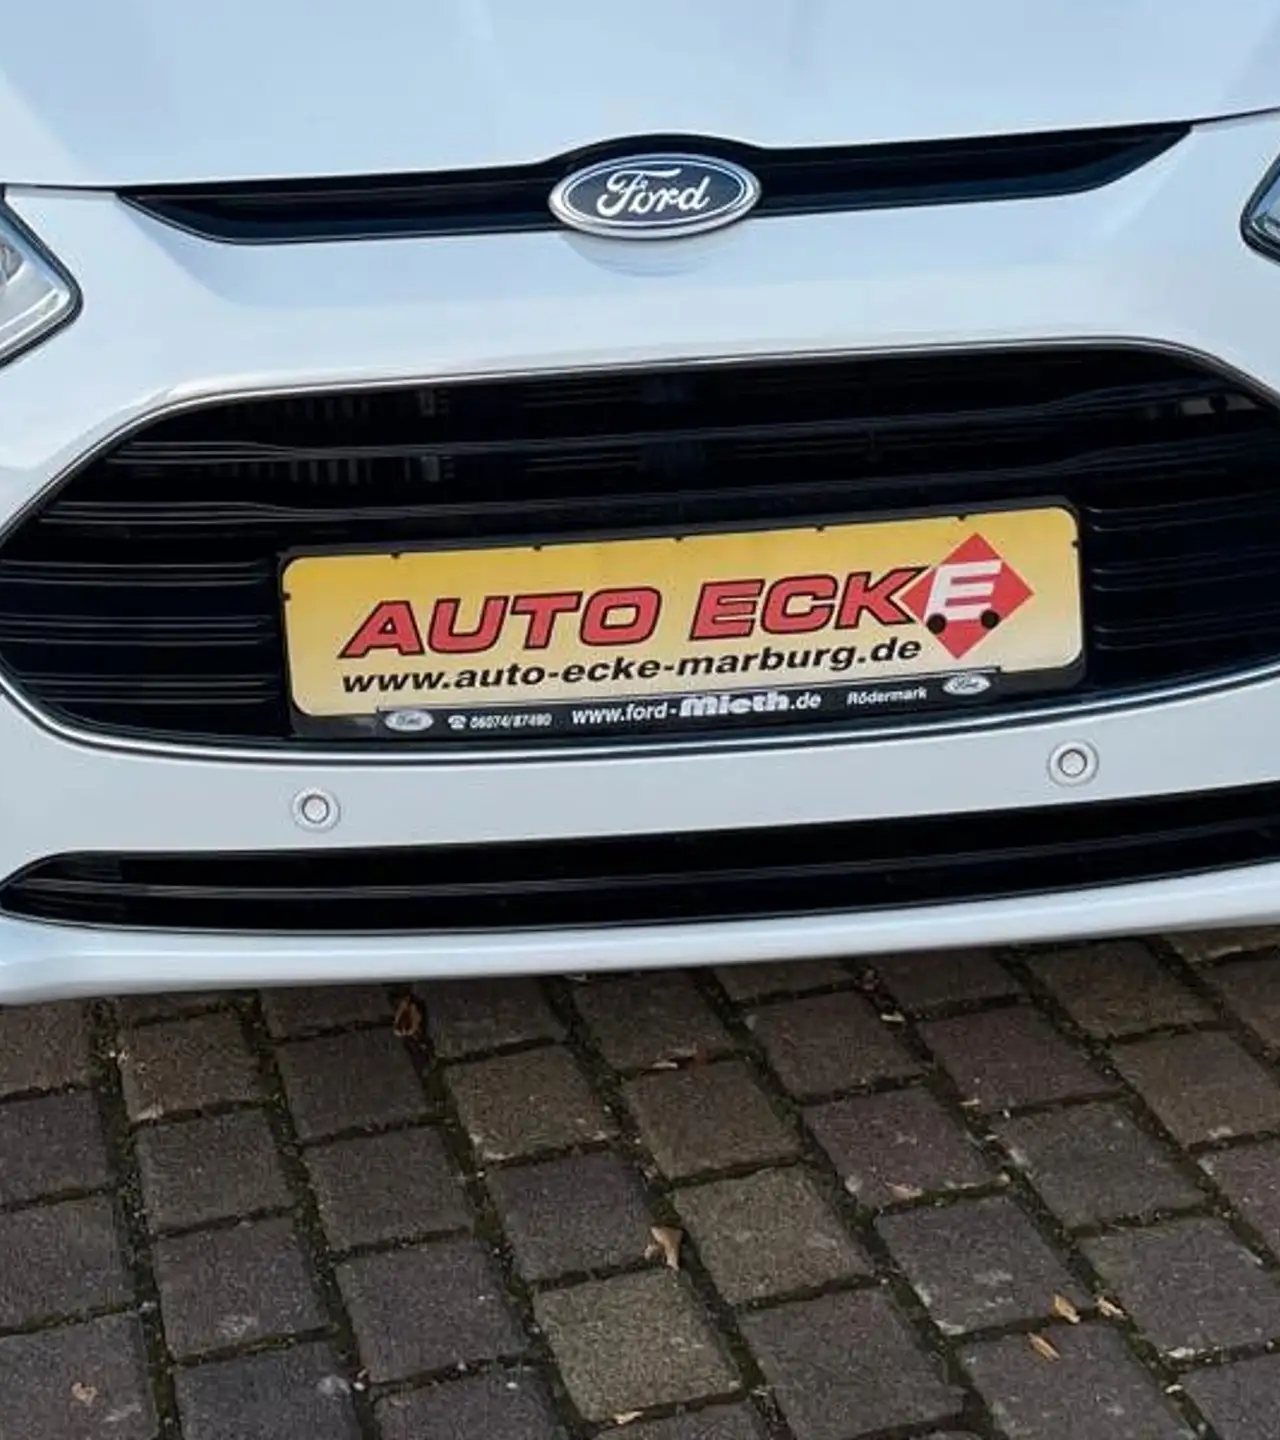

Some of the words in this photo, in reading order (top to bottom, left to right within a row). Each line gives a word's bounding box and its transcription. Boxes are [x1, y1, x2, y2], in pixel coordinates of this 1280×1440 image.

[596, 167, 711, 218] Ford
[337, 586, 662, 659] AUTO
[342, 637, 922, 693] www.auto-ecke-marburg.de
